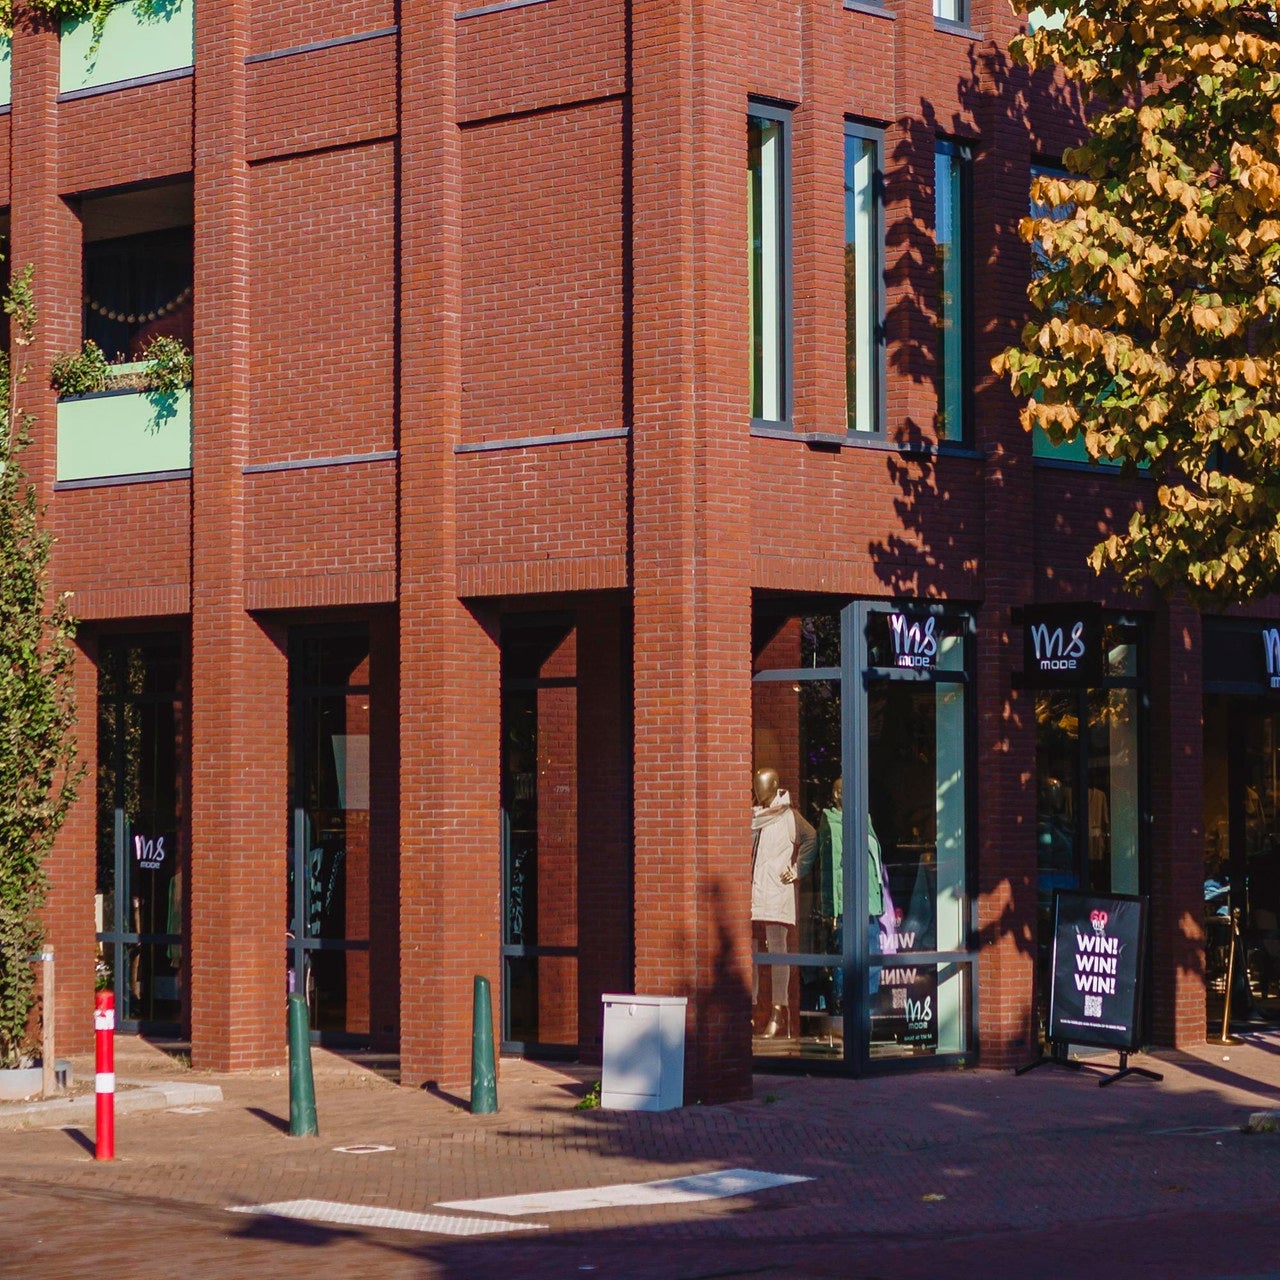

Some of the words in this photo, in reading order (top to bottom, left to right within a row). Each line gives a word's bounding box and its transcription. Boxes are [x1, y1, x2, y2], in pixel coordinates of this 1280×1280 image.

[1040, 659, 1078, 671] mode
[1076, 934, 1119, 956] WIN!
[1075, 954, 1118, 975] WIN!
[1074, 973, 1117, 995] WIN!
